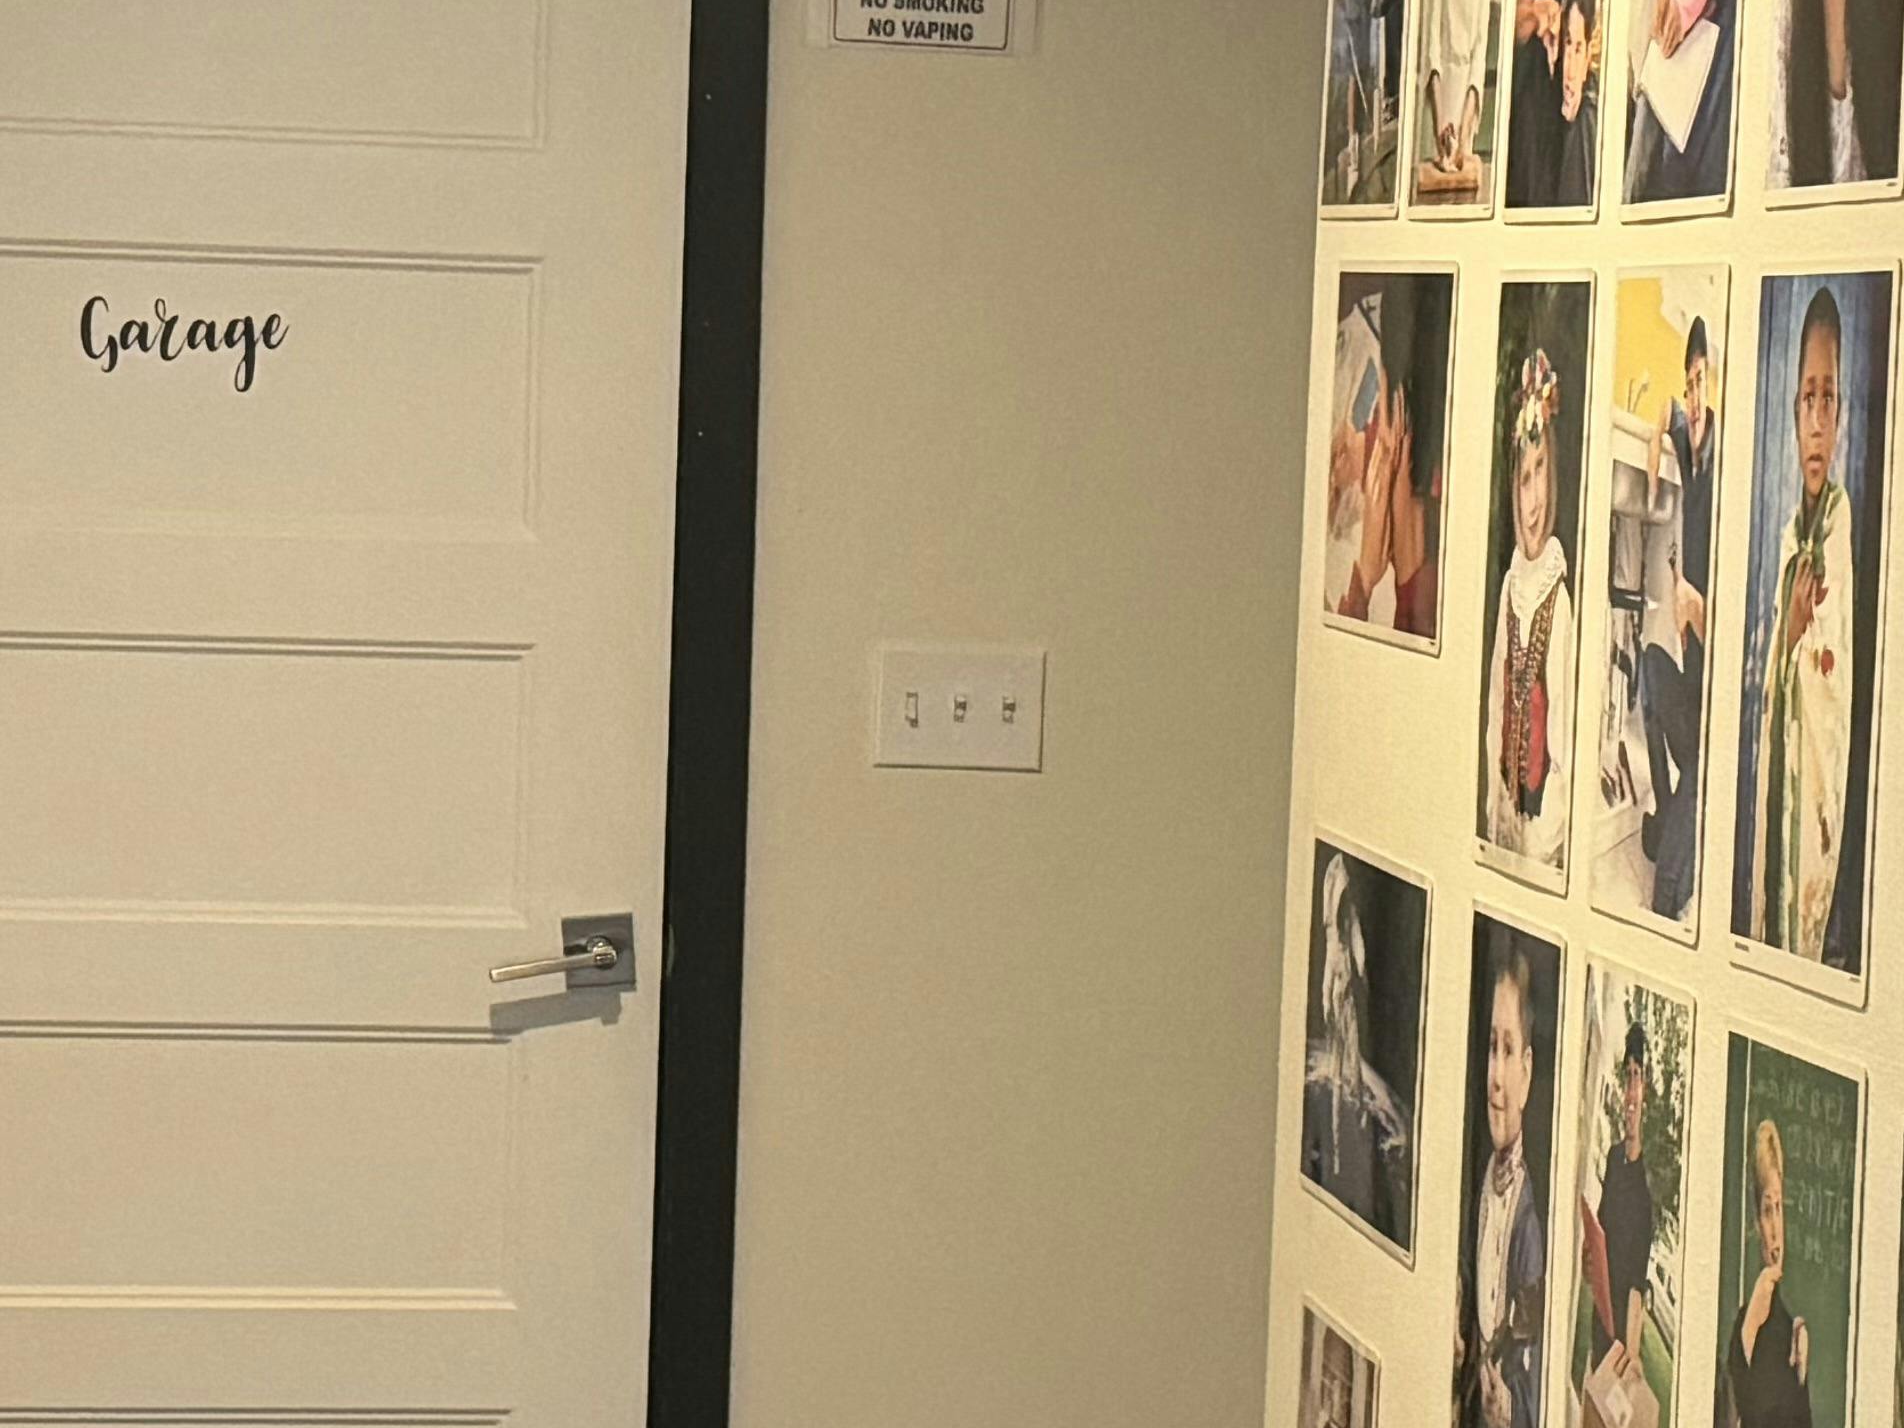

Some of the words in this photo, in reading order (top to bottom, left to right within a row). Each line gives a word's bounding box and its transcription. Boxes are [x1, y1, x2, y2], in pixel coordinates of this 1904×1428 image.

[867, 18, 896, 37] NO
[902, 20, 974, 41] VAPING
[80, 295, 290, 392] Garage
